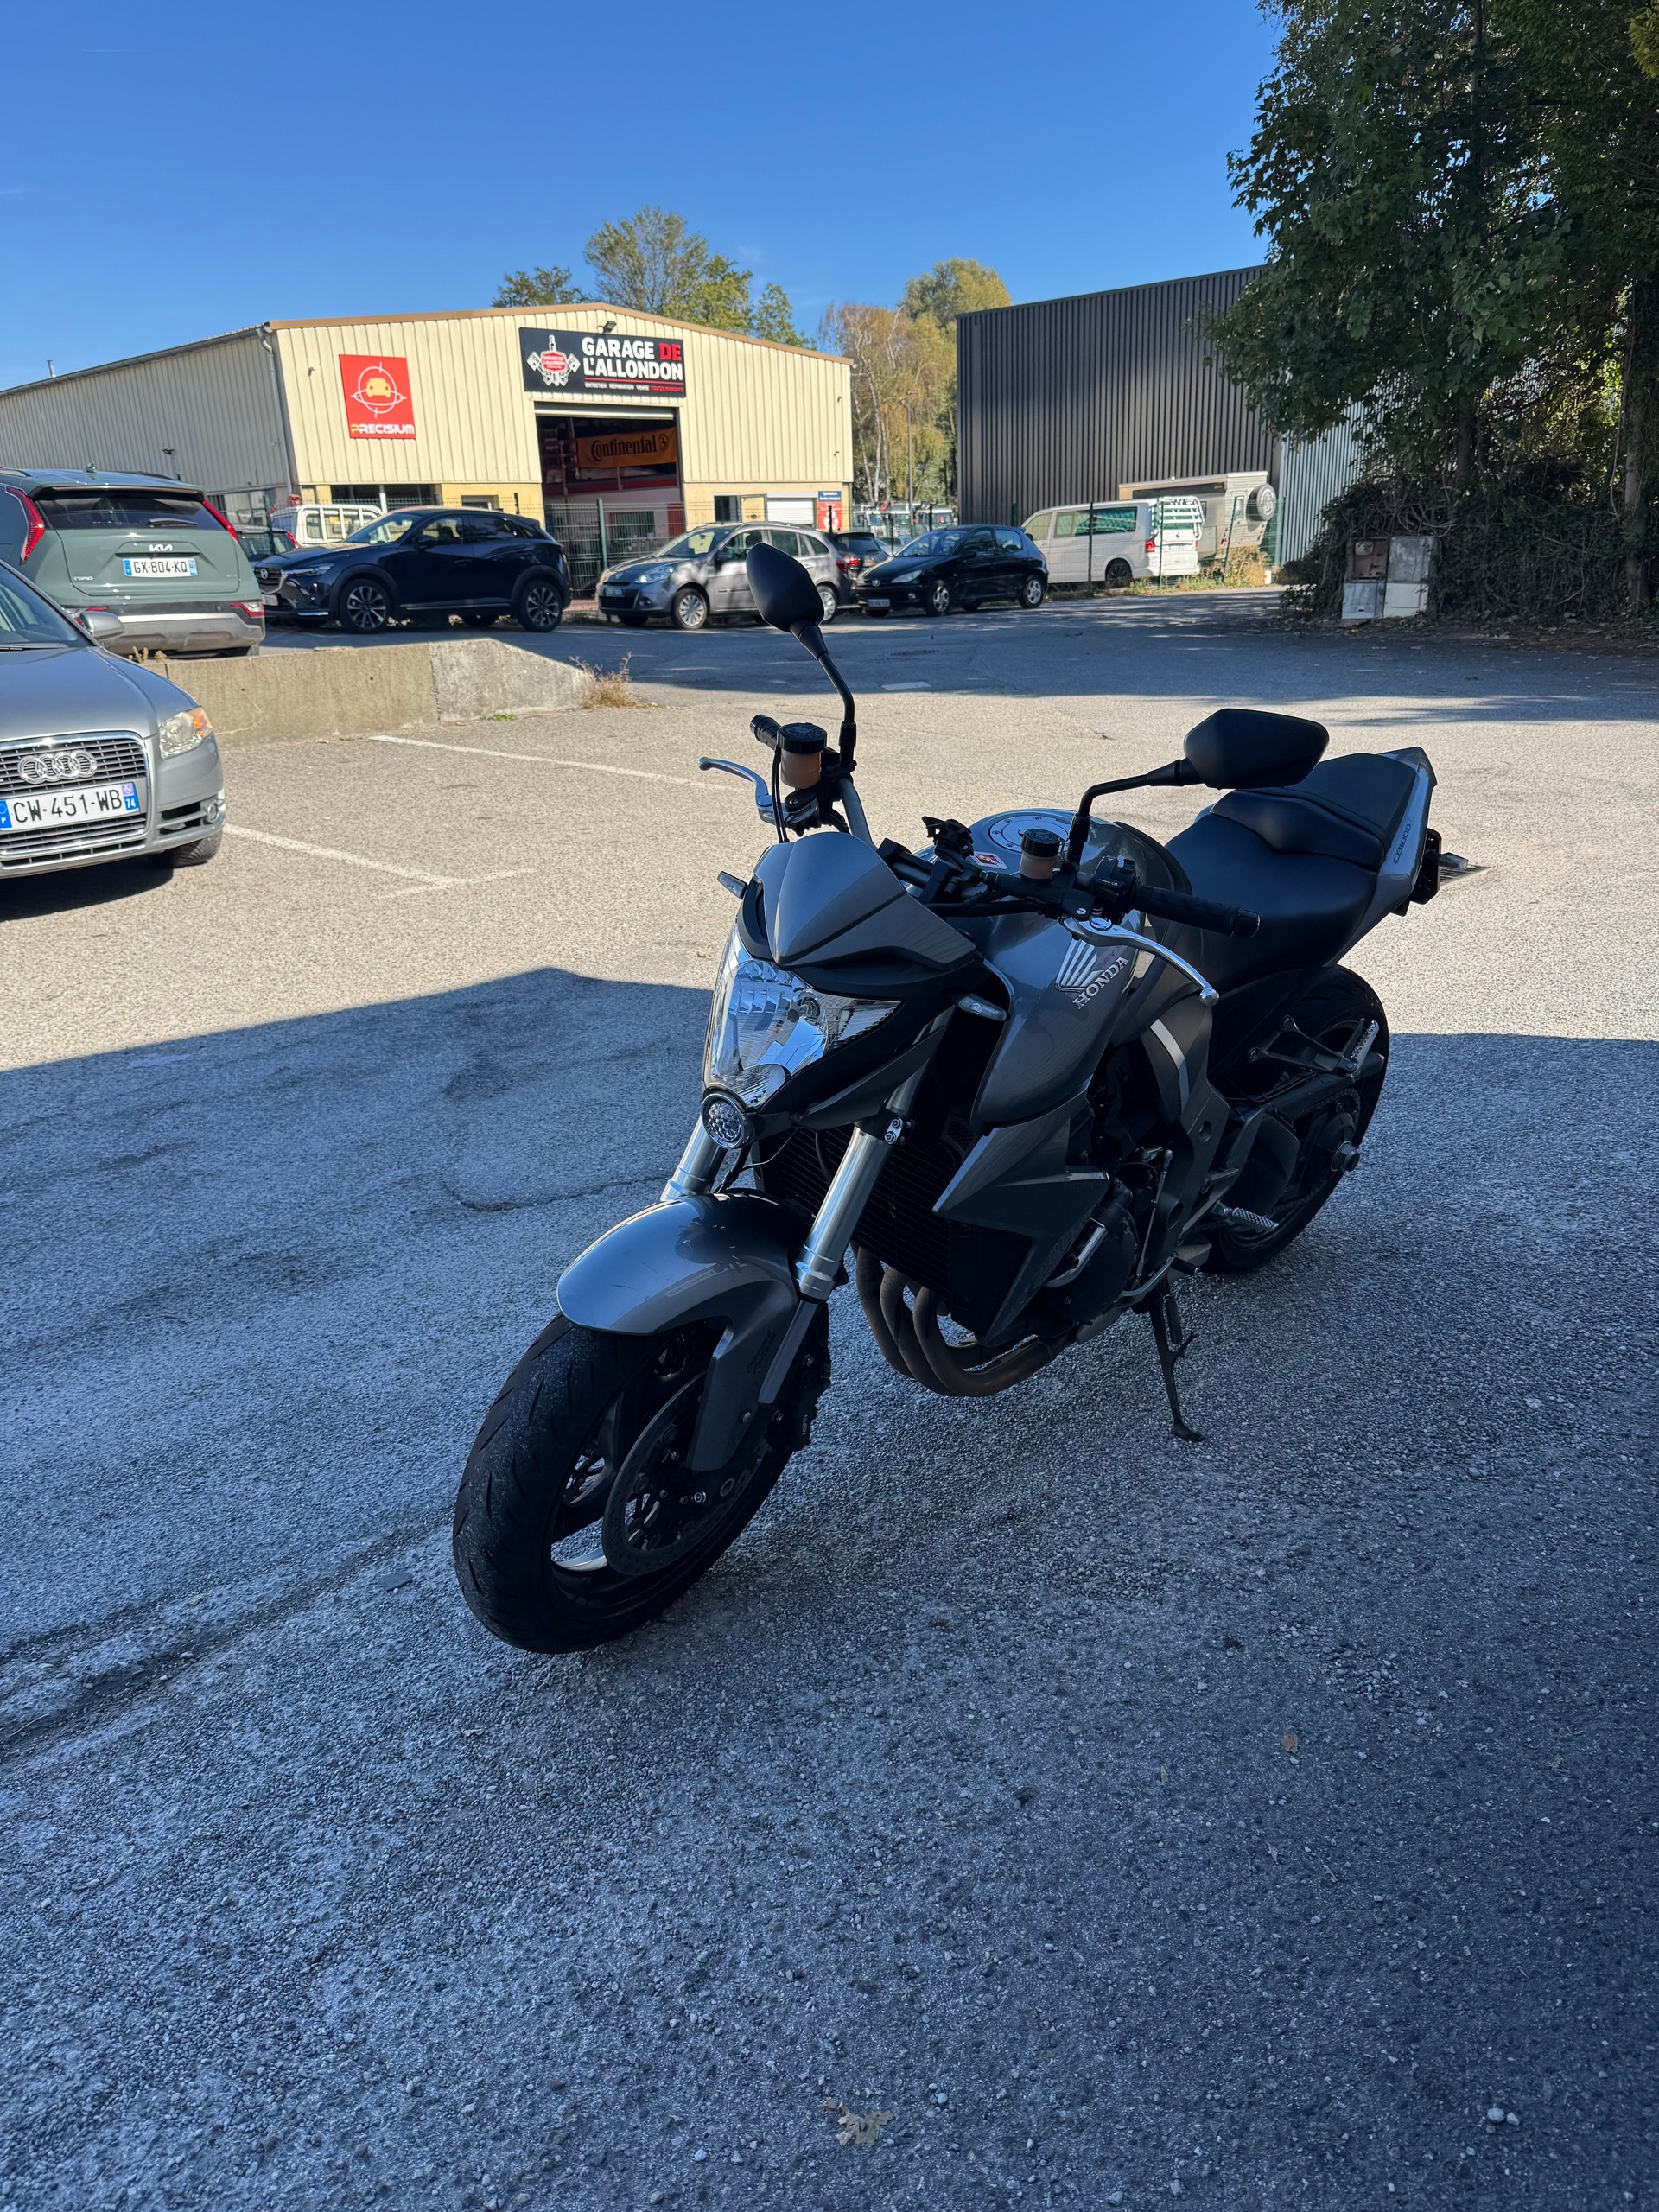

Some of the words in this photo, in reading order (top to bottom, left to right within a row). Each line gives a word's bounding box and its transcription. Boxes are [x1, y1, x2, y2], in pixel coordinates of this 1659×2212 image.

[582, 337, 655, 359] GARAGE
[659, 342, 682, 361] DE
[582, 357, 683, 381] L'ALLONDON
[350, 423, 415, 435] PRECISIUM
[591, 435, 657, 461] Continental
[133, 561, 188, 574] GX-804-KQ
[13, 789, 122, 823] CW-451-WB
[125, 798, 137, 809] 74
[1072, 957, 1129, 1010] HONDA
